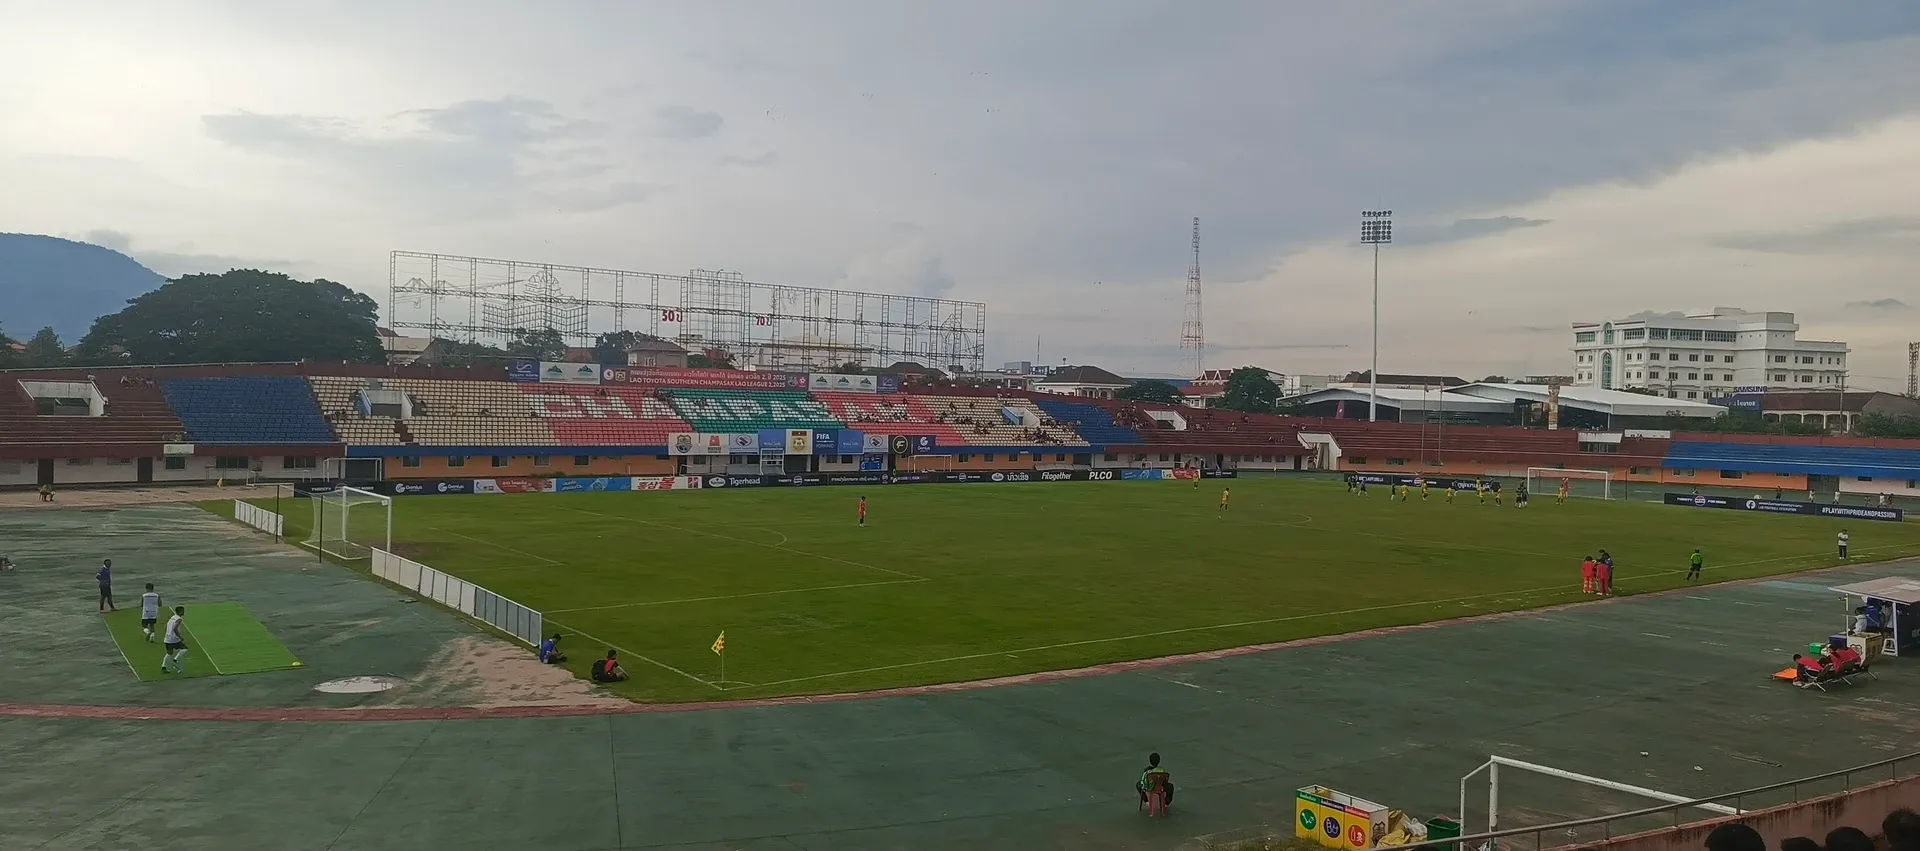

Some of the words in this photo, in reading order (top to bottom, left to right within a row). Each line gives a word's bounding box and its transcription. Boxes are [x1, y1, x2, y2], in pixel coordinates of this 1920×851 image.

[662, 309, 674, 322] 50
[667, 378, 698, 386] SOUTHERN
[699, 379, 735, 387] CHAMPASAK
[747, 380, 768, 388] LEAGUE
[1041, 471, 1072, 481] Fitogether
[1089, 471, 1113, 480] PLCO
[729, 477, 761, 486] Tigerhead
[1821, 507, 1897, 519] #PLAYWITHPRIDEANDPASSION
